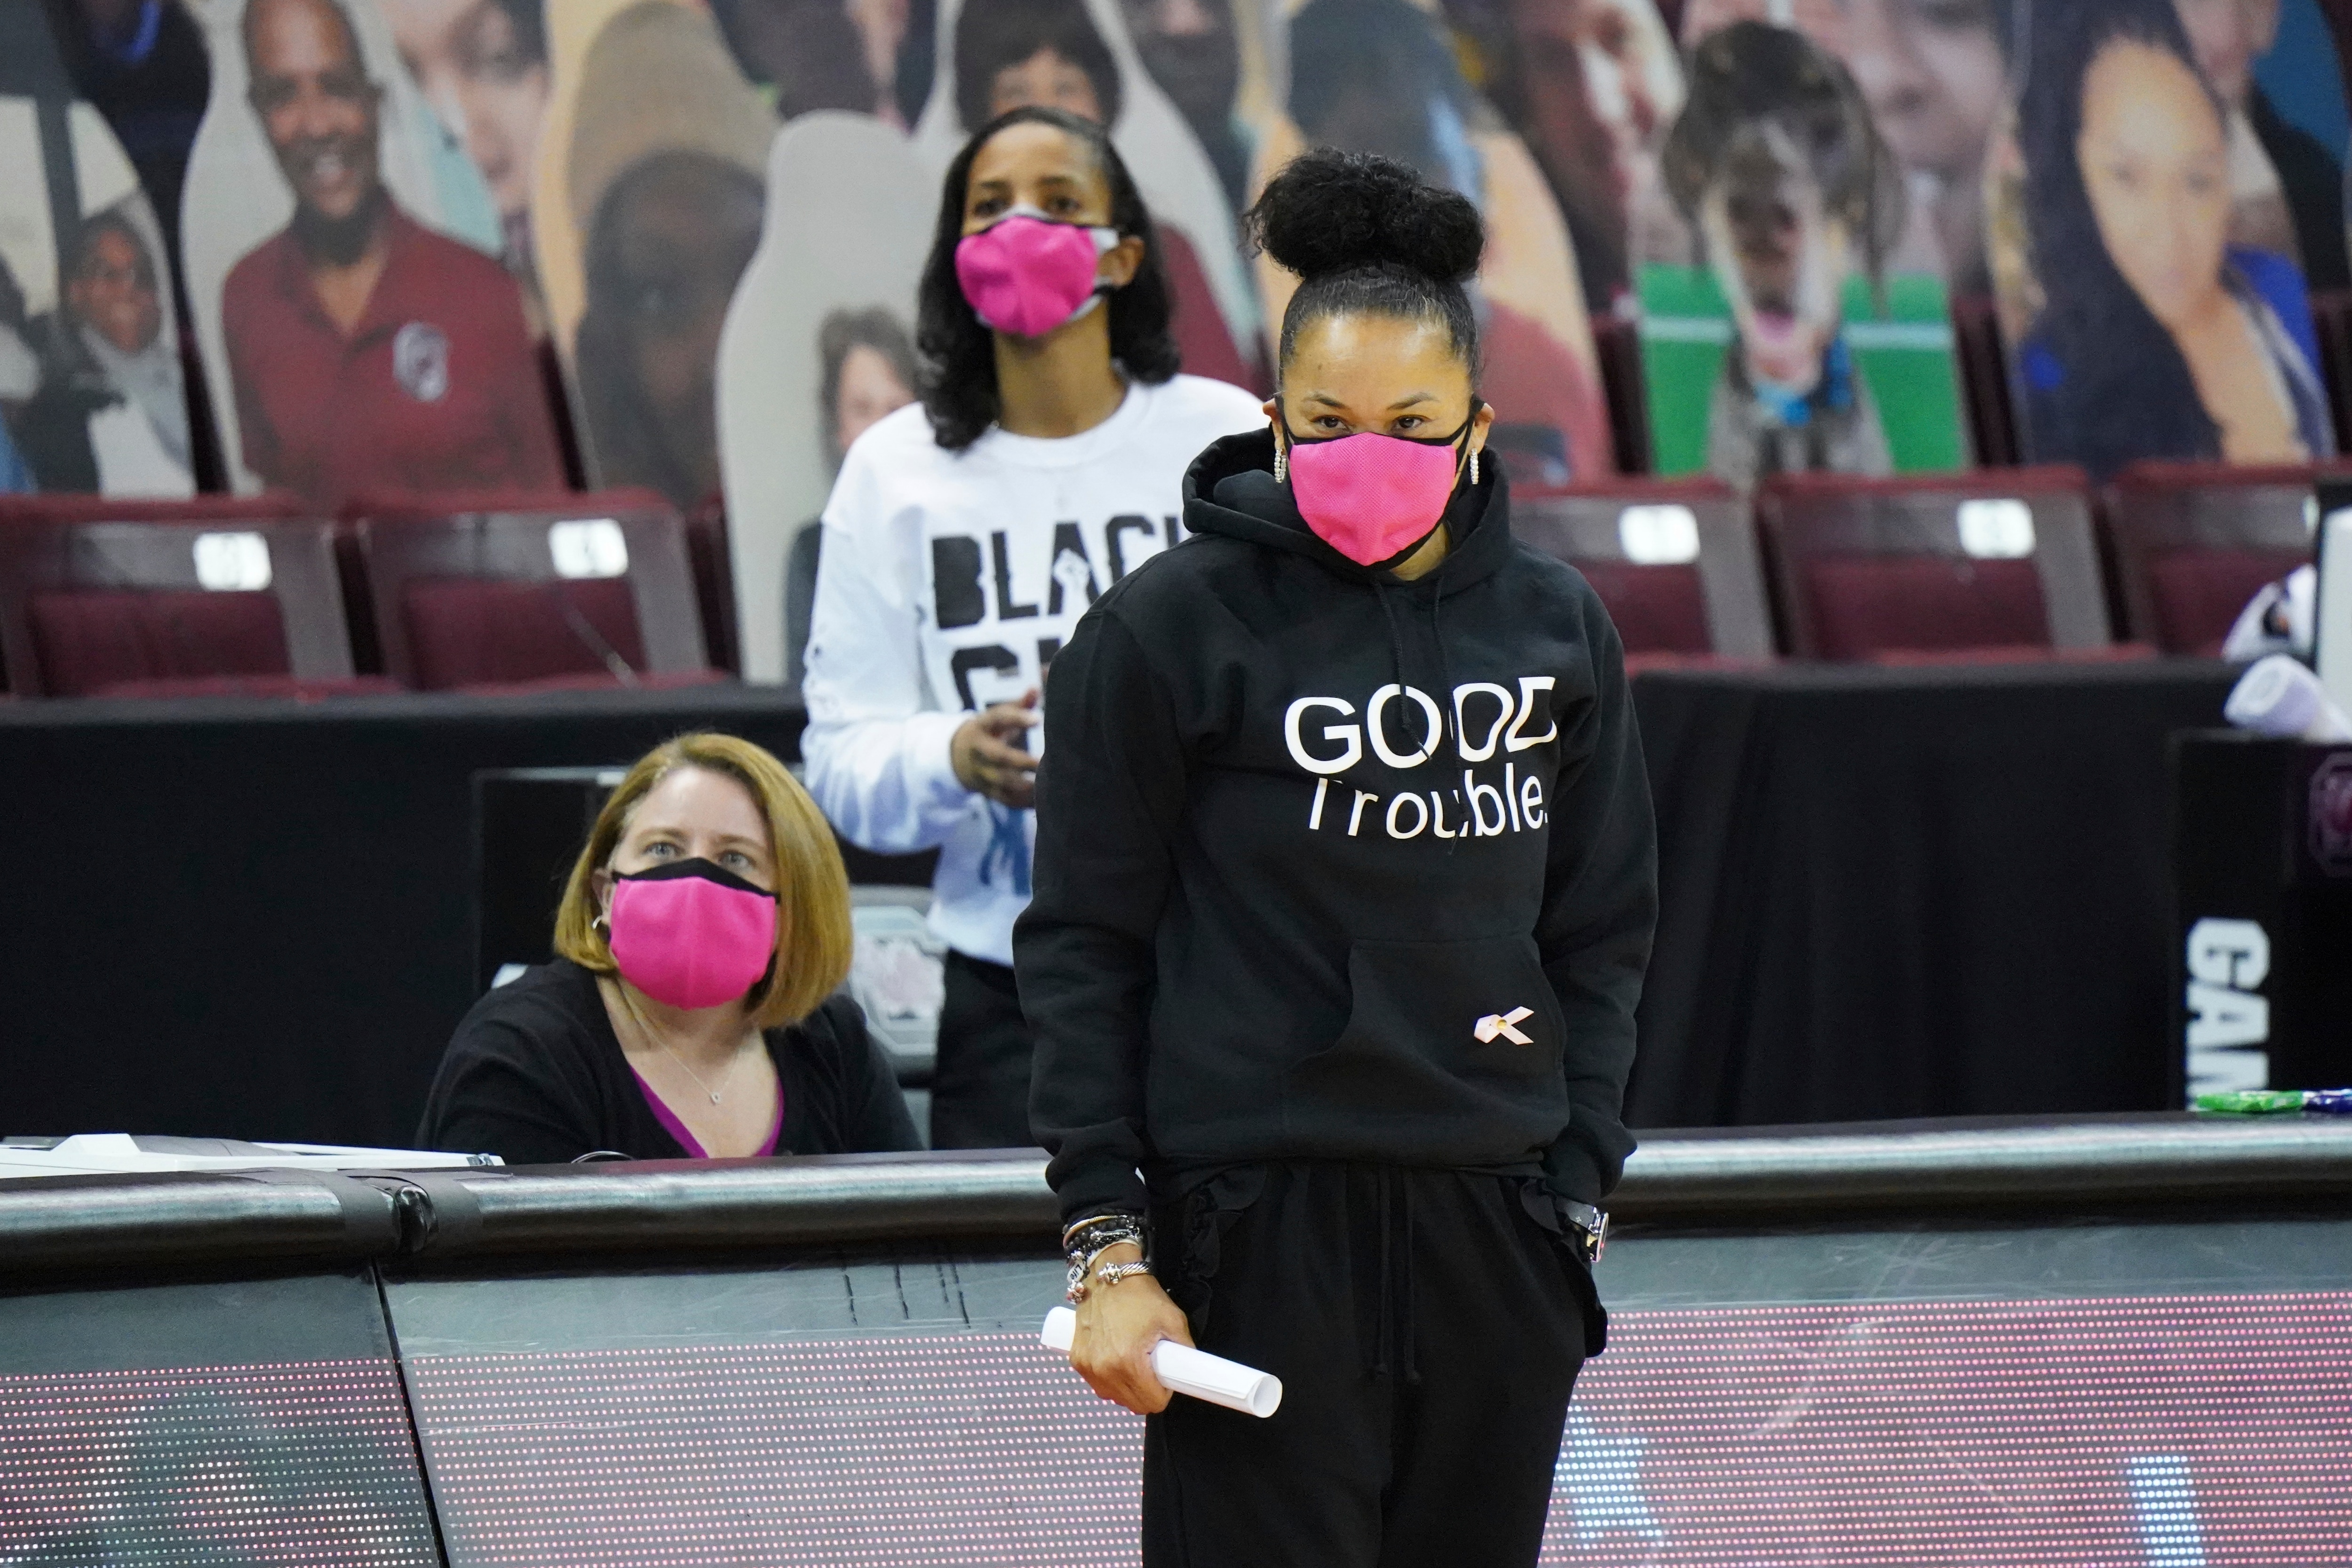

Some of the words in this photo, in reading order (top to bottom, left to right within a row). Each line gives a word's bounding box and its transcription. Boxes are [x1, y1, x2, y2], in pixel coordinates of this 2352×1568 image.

[932, 515, 1180, 630] BLAC
[1284, 676, 1557, 774] GOOD
[1070, 1264, 1082, 1280] Life
